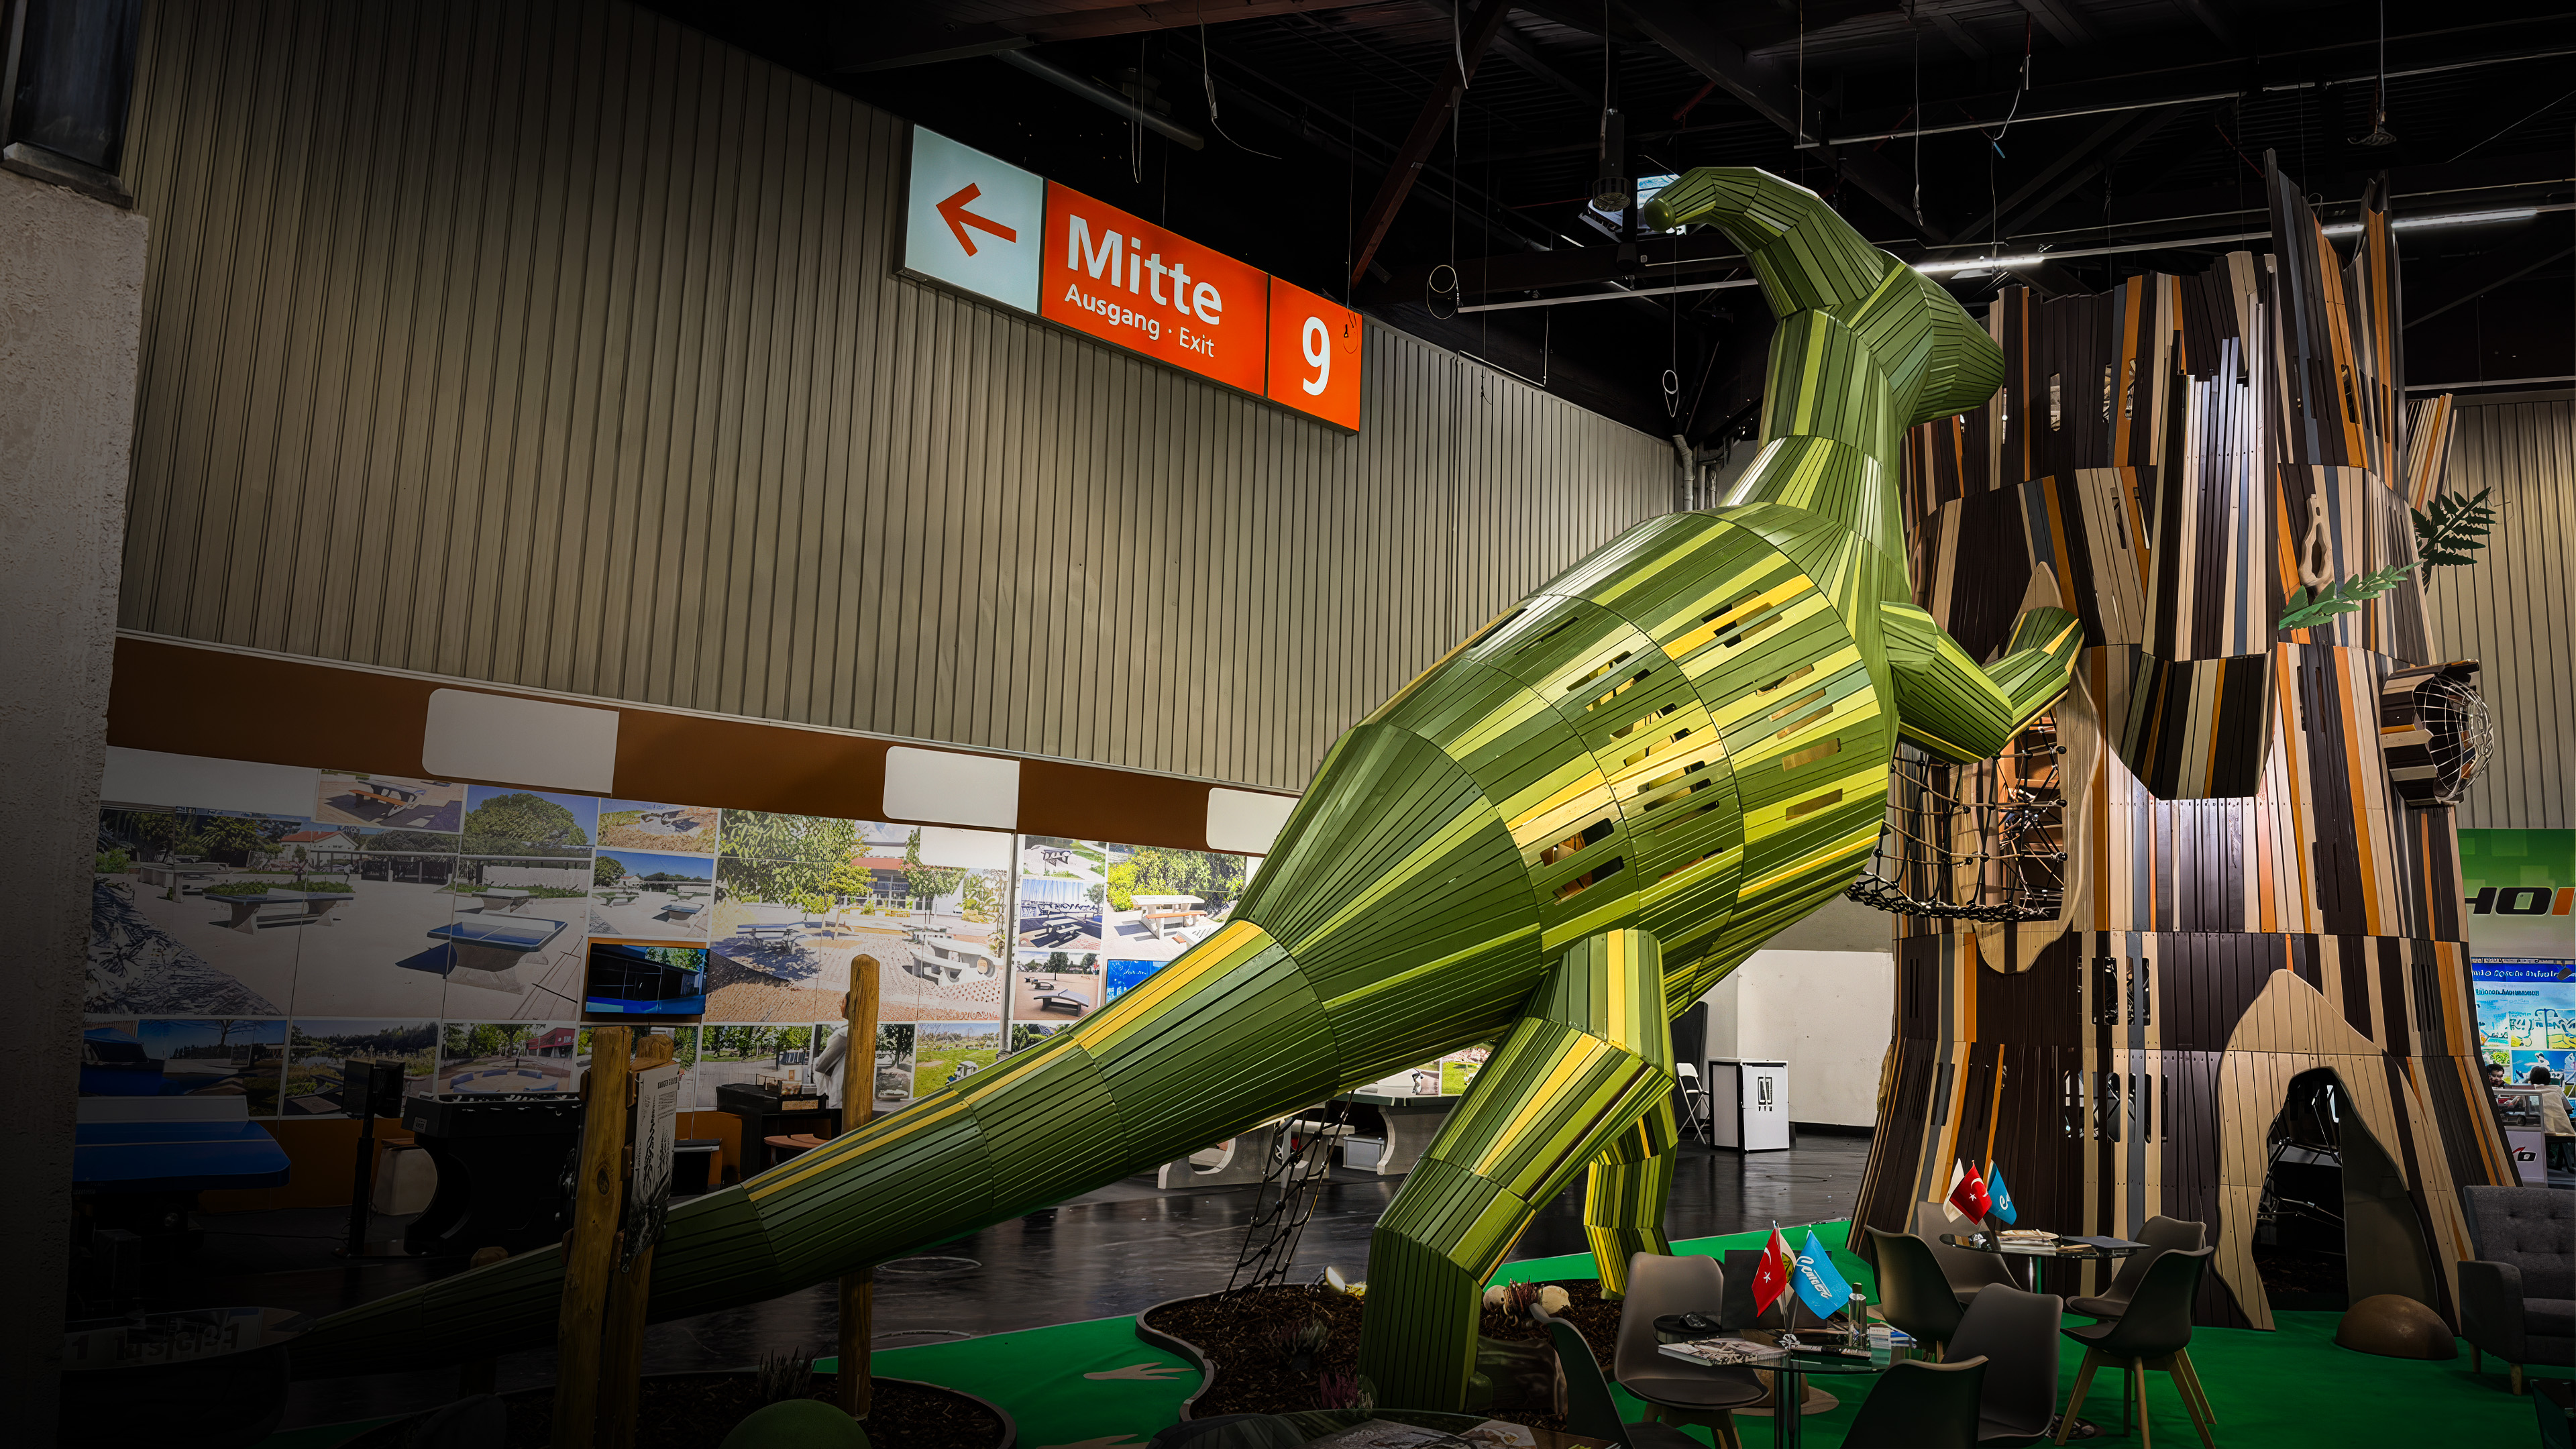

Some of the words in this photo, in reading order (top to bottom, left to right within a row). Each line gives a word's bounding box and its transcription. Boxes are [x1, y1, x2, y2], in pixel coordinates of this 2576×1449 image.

[1067, 213, 1222, 325] Mitte
[1064, 283, 1160, 341] Ausgang
[1179, 326, 1215, 358] Exit
[1302, 316, 1331, 396] 9
